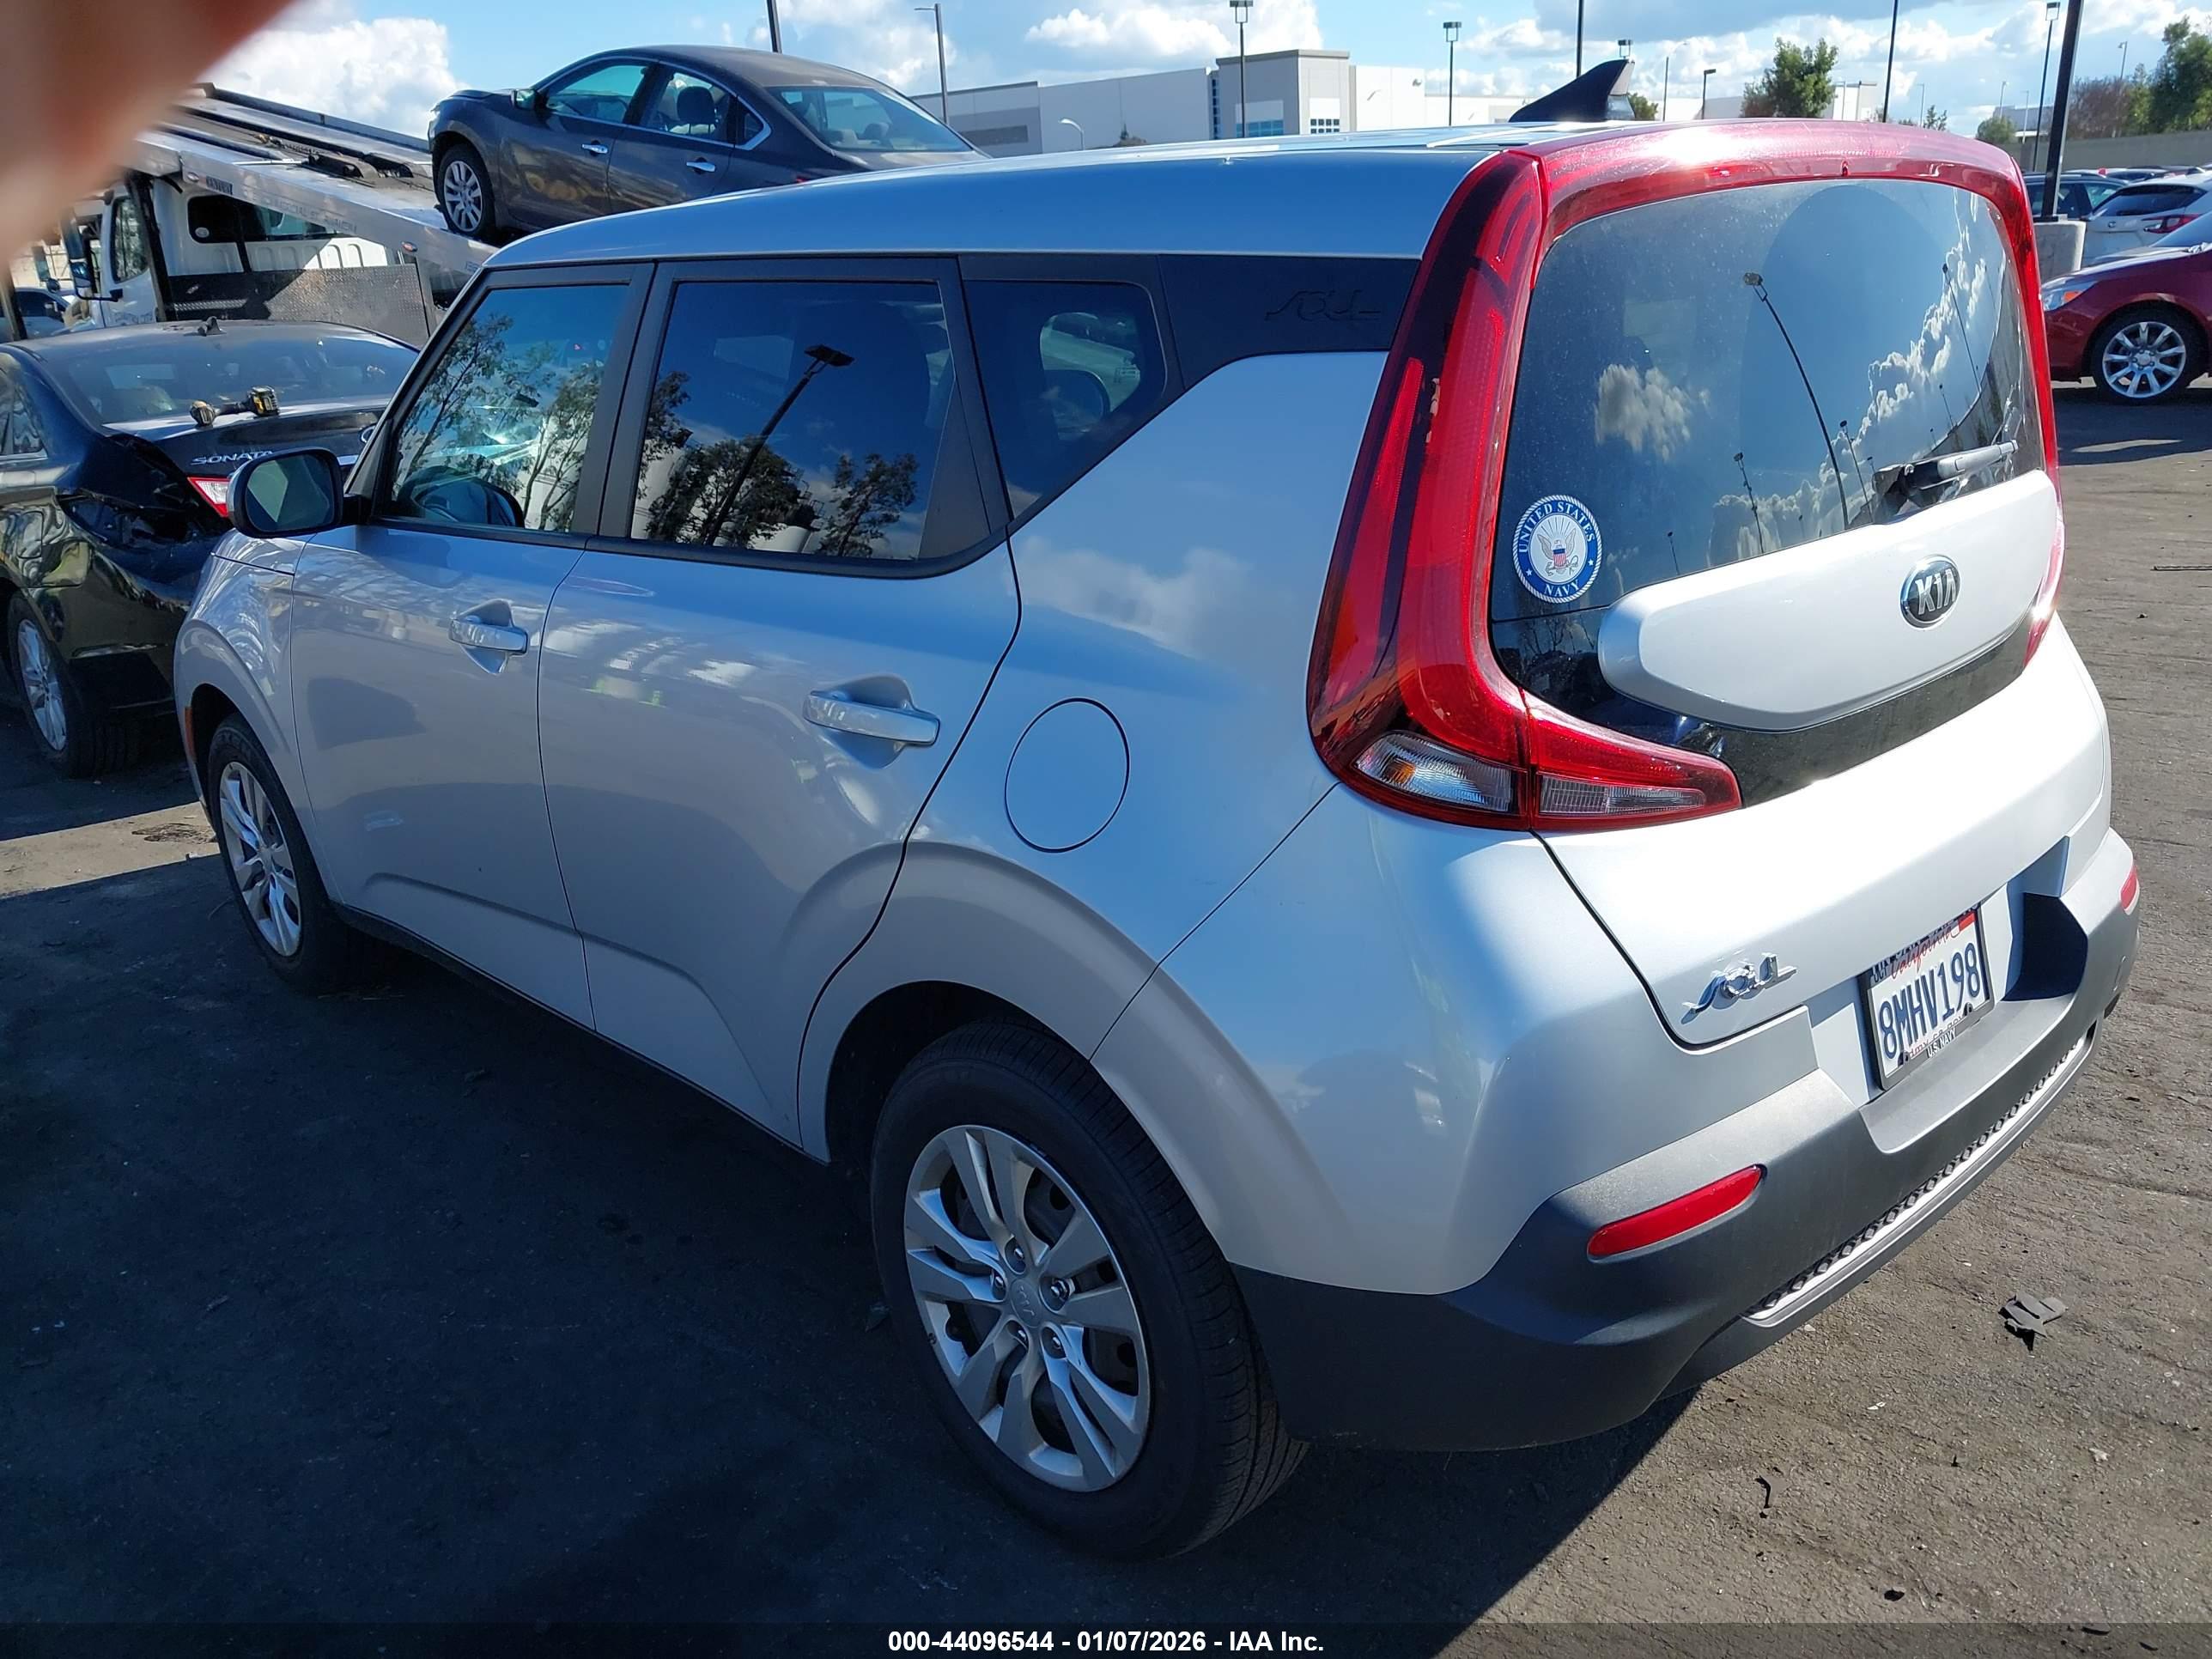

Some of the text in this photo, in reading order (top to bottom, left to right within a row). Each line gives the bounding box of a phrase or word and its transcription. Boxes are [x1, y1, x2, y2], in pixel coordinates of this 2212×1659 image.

[191, 450, 273, 465] SONATA
[1518, 501, 1595, 553] UNITED STATES
[1544, 579, 1580, 597] NAVY
[1915, 568, 1958, 616] KIA
[1879, 942, 1982, 1060] 8MHV198
[1939, 1026, 1957, 1049] NAVY
